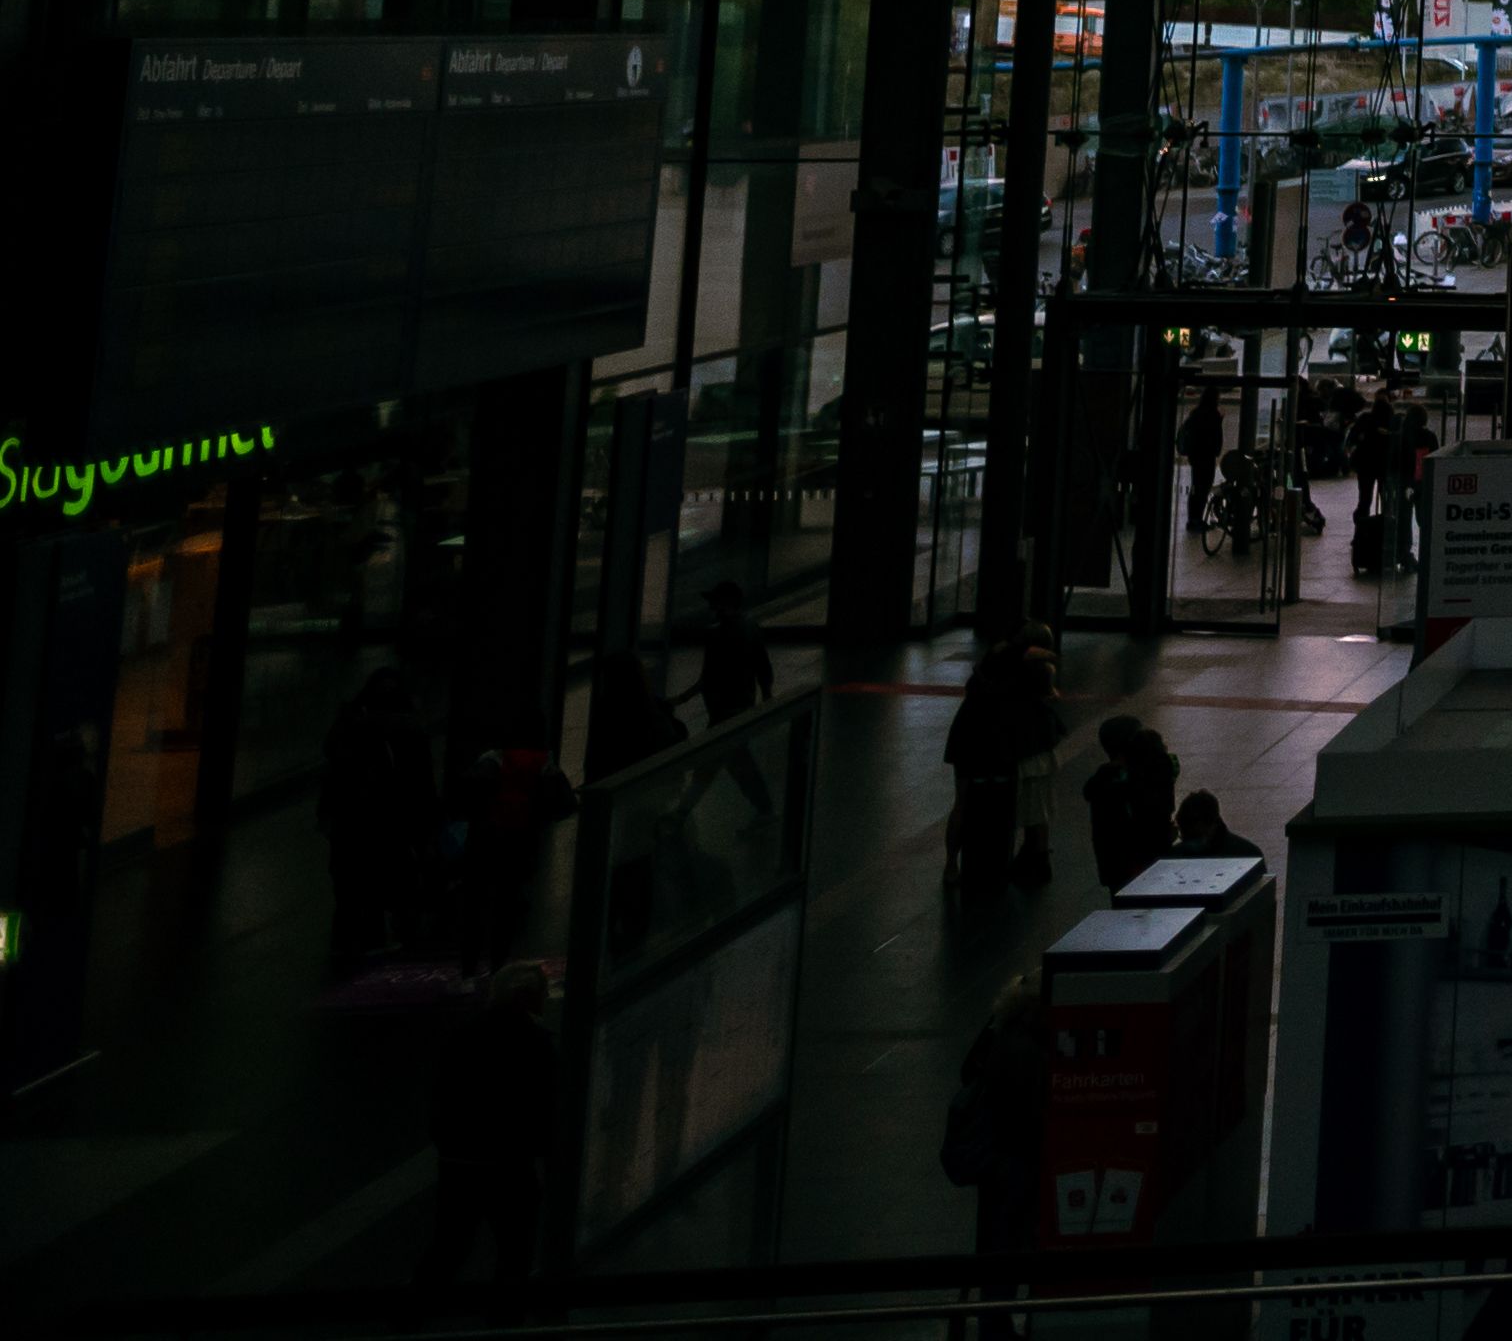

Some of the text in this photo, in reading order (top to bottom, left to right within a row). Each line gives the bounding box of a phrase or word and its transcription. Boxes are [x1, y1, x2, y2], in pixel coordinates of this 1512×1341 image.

[139, 53, 198, 82] Abfahrt
[1450, 476, 1476, 493] DB
[1444, 545, 1488, 556] unsere
[1307, 899, 1338, 915] Mein
[1050, 1071, 1145, 1089] Fahrkarten
